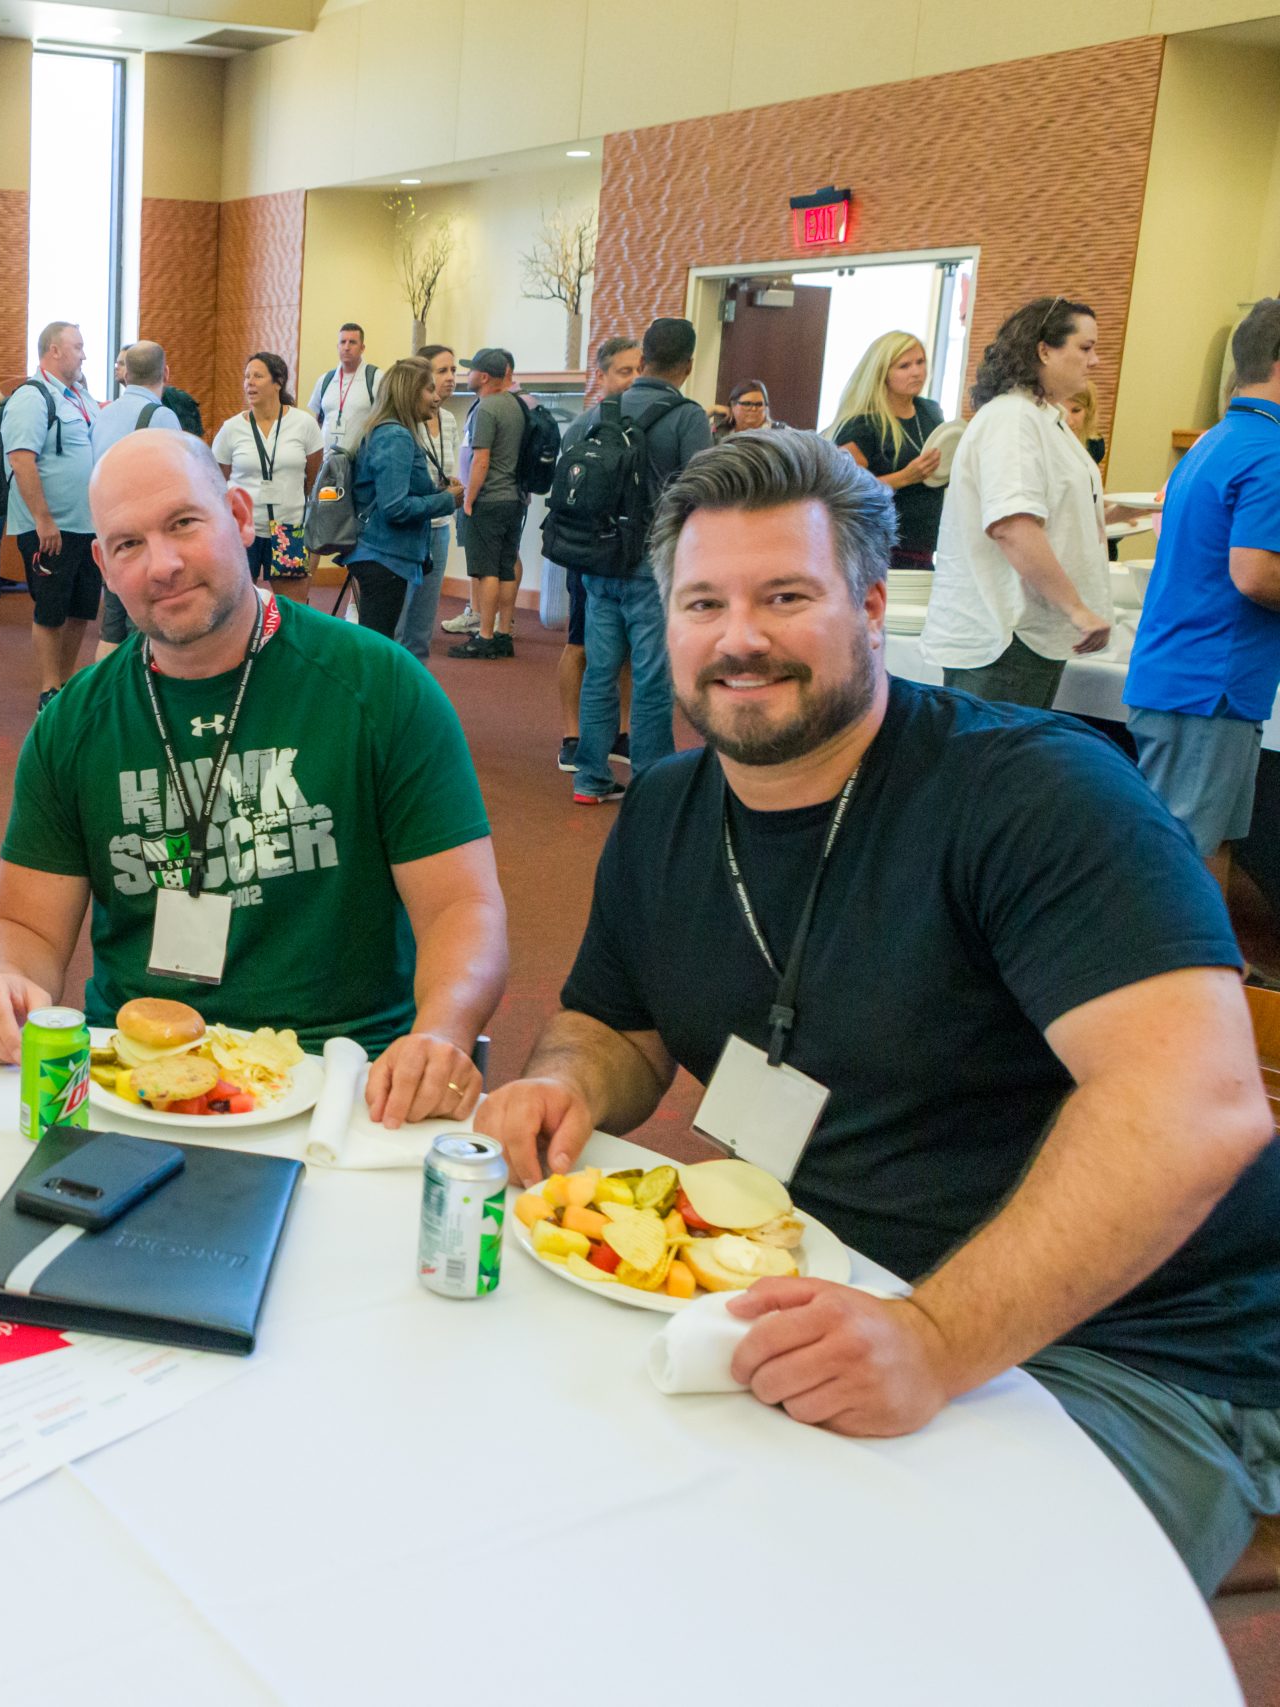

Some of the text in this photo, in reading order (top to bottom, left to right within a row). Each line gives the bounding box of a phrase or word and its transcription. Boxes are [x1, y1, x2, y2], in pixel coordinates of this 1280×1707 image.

[805, 206, 838, 243] EXIT
[227, 719, 235, 734] Credit
[231, 705, 239, 719] Union
[165, 745, 191, 817] Credit Union National Association
[211, 767, 221, 787] National
[217, 740, 230, 767] Association
